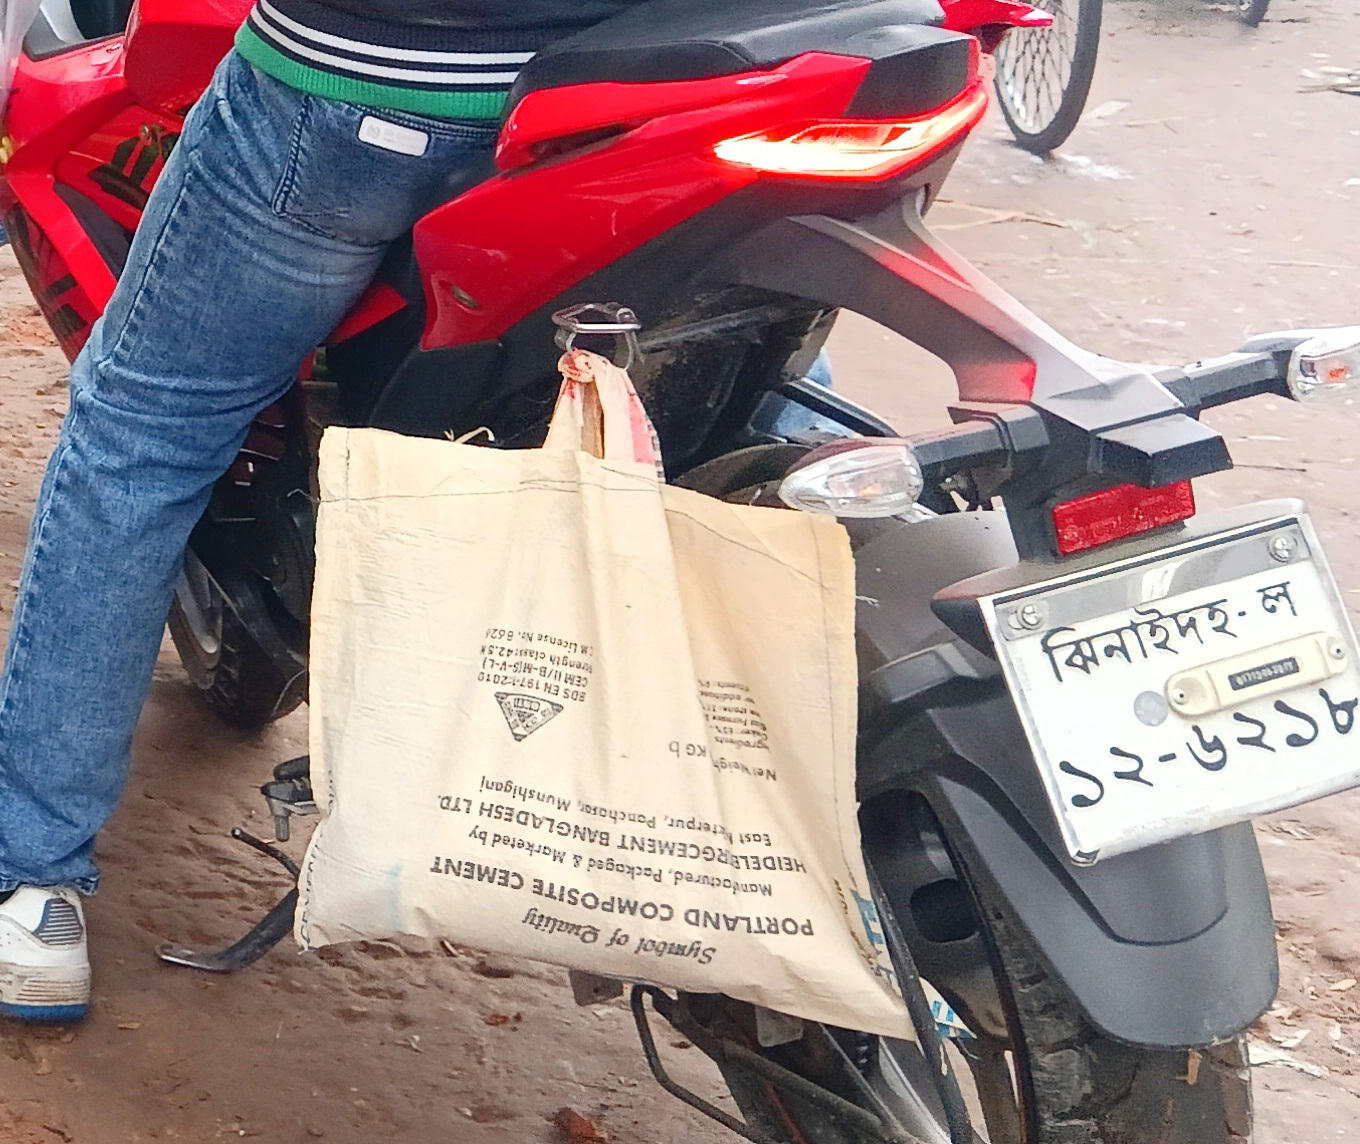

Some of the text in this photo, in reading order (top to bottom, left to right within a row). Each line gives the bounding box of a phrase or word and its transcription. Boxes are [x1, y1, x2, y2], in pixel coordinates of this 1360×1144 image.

[537, 633, 578, 653] License
[544, 682, 559, 696] EN
[564, 673, 588, 688] CEM
[1059, 689, 1359, 807] ১২-৬২১৮
[437, 795, 472, 815] LTD.
[478, 776, 571, 813] Munshiganj
[478, 801, 610, 847] BANGLADESH
[468, 827, 488, 849] by
[492, 833, 566, 864] Marketed
[738, 832, 771, 847] East
[571, 854, 582, 867] &
[586, 858, 663, 883] Packaged
[430, 856, 814, 937] PORTLAND COMPOSITE CEMENT
[522, 908, 717, 965] Symbol of Quality
